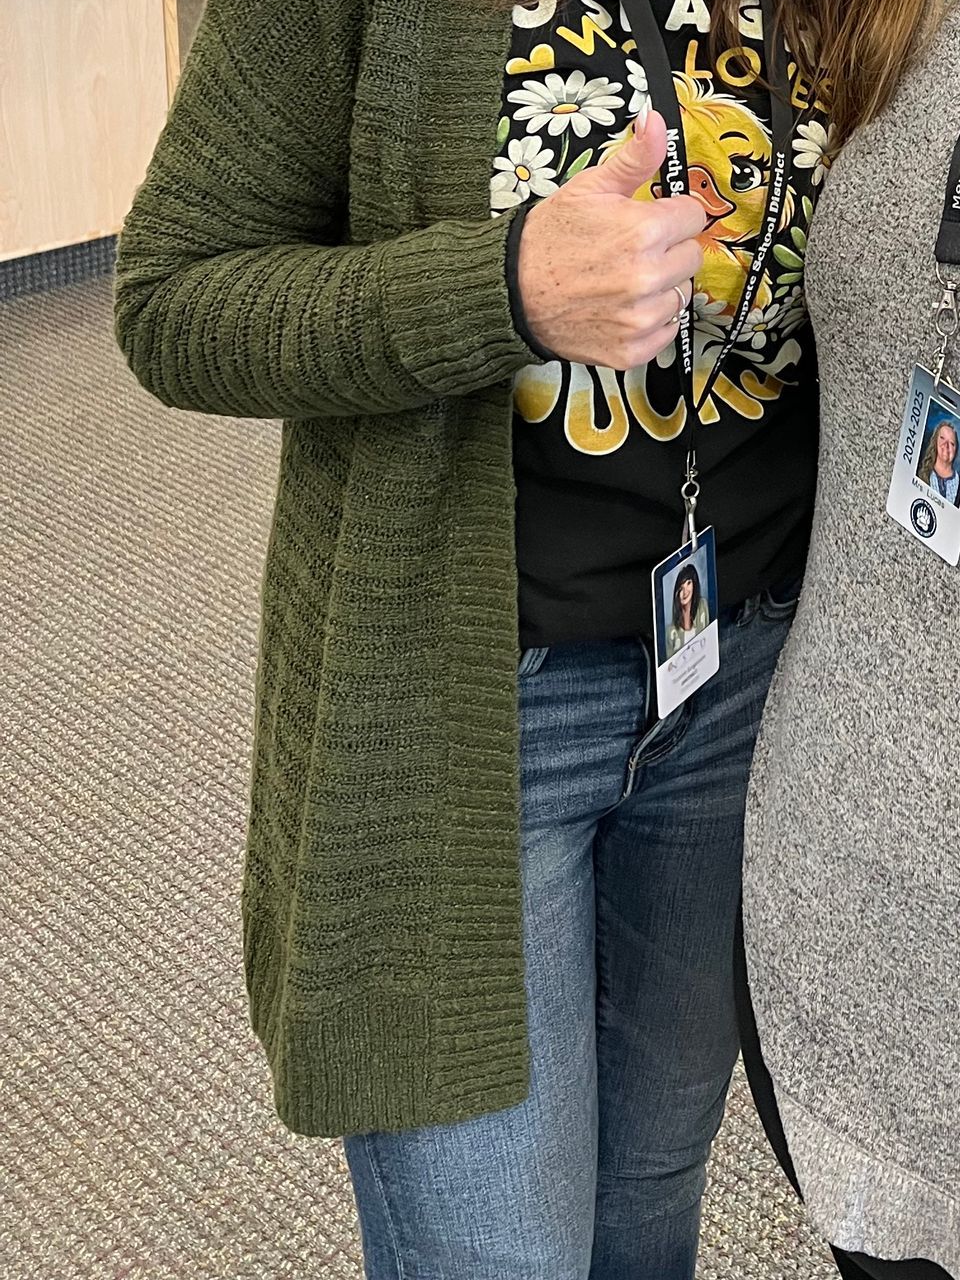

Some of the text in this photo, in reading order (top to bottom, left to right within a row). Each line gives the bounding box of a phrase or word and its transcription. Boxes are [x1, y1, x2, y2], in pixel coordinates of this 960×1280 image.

[752, 216, 776, 272] School
[769, 151, 785, 215] District
[903, 391, 925, 464] 2024-2025
